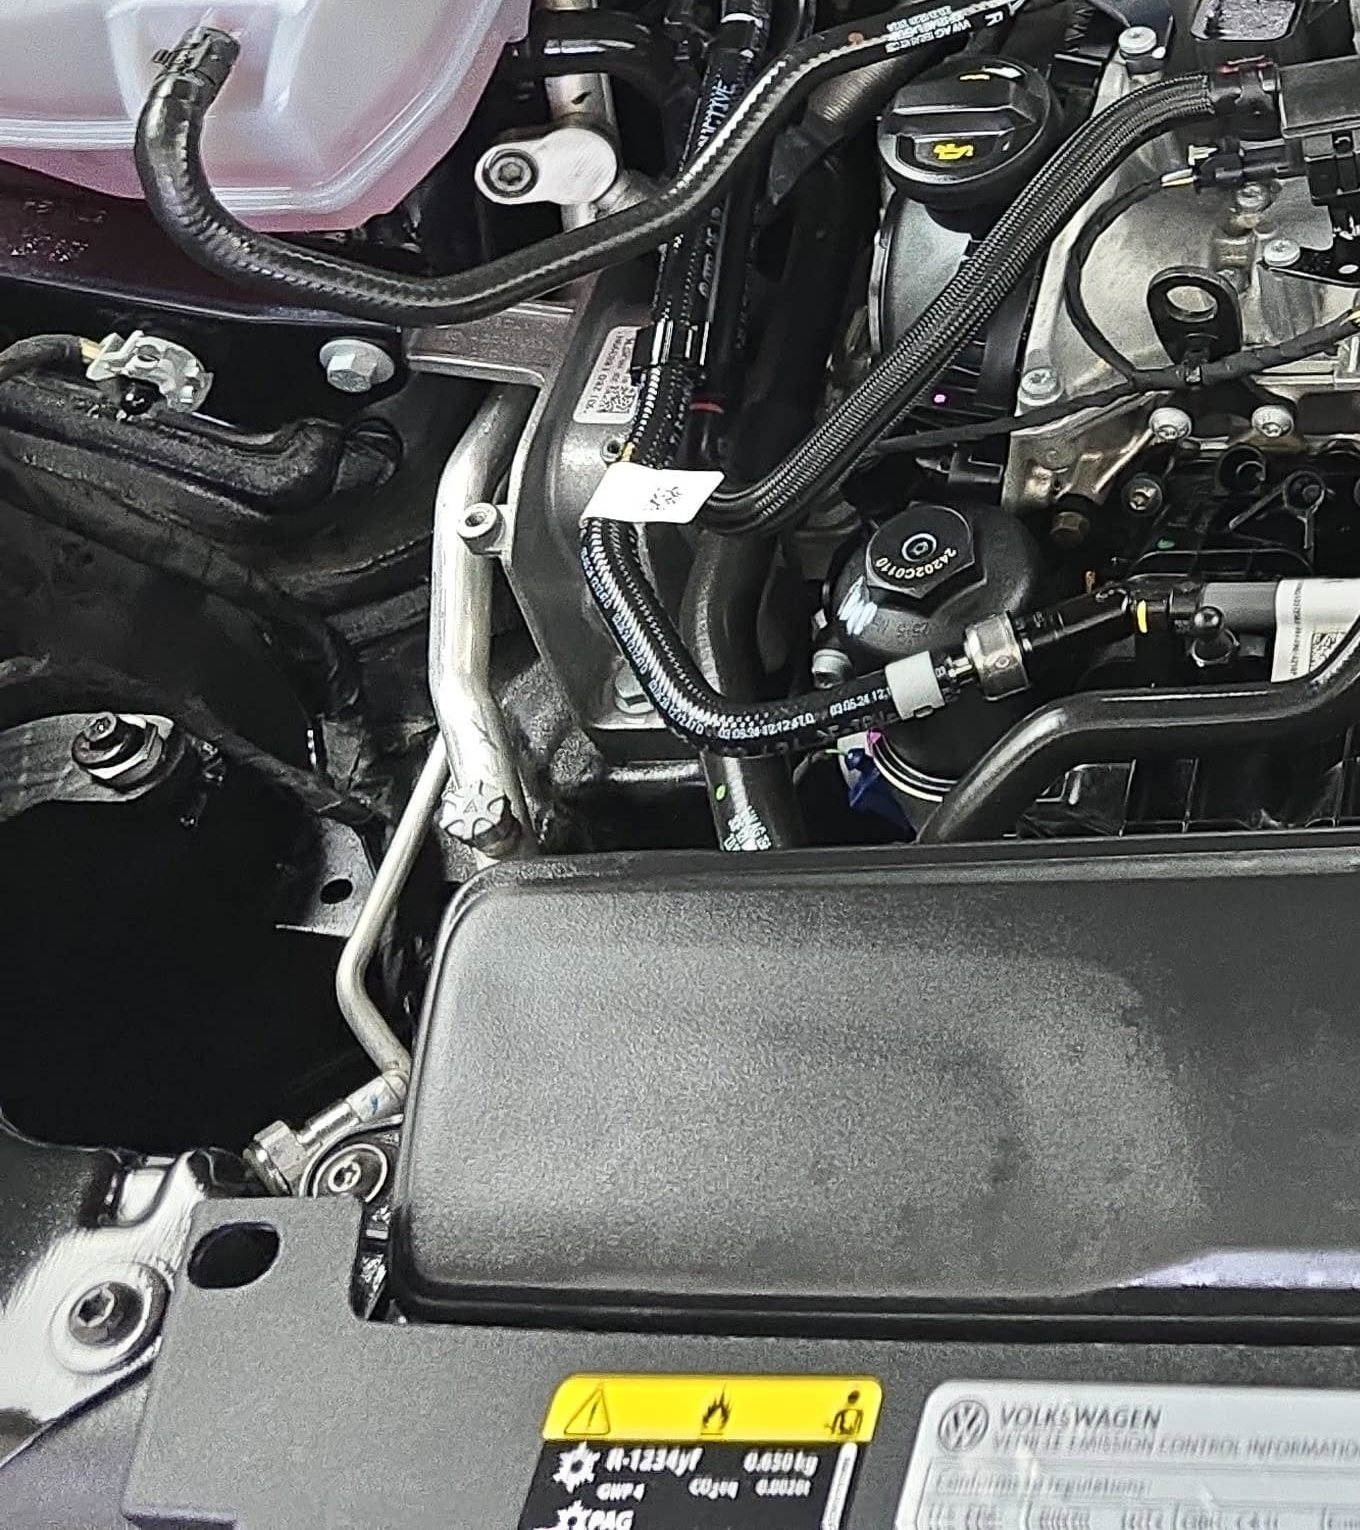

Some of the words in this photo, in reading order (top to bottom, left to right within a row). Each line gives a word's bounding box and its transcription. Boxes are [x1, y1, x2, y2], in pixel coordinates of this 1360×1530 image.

[998, 1404, 1163, 1431] VOLKSWAGEN
[1160, 1436, 1242, 1456] CONTROL
[604, 1446, 703, 1478] R-1234yf
[792, 1449, 819, 1478] kg
